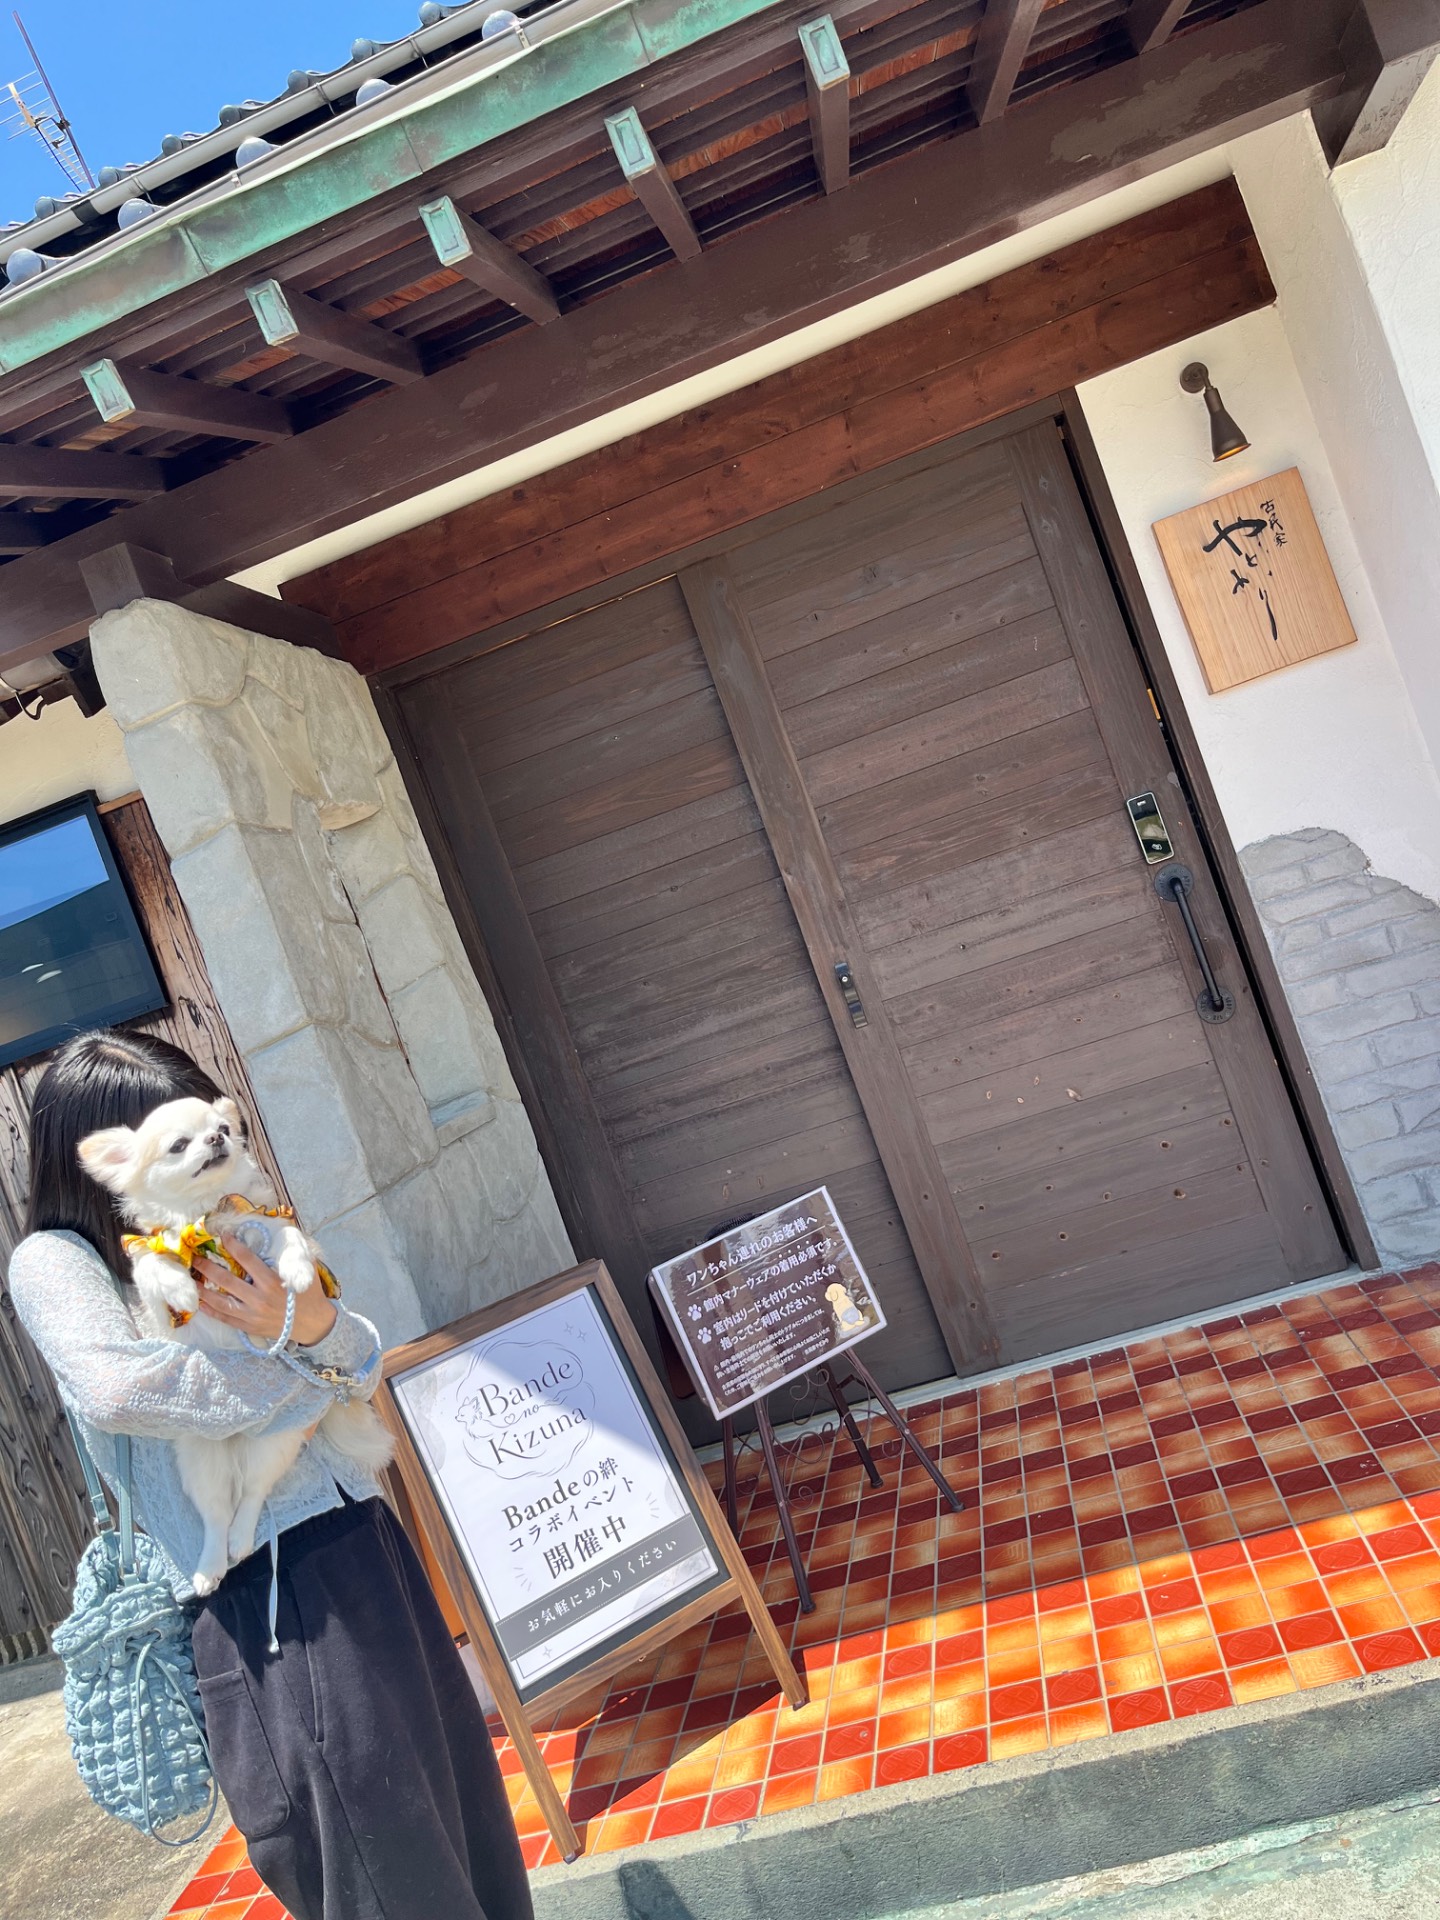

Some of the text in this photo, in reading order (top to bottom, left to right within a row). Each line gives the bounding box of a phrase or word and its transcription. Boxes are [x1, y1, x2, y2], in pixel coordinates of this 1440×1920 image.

[1260, 498, 1288, 547] 古民家
[686, 1215, 818, 1287] ワンちゃん連れのお客様へ
[703, 1238, 837, 1312] 館内マナーウェアの着用必須です。
[713, 1263, 837, 1335] 室内はリードを付けていただくか
[720, 1296, 817, 1351] 抱っこでご利用ください。
[476, 1361, 574, 1418] Bande
[523, 1403, 541, 1418] no
[487, 1408, 588, 1465] Kizuna
[501, 1457, 618, 1531] Bandeの絆
[508, 1476, 635, 1554] コラボイベント
[542, 1514, 627, 1580] 開催中
[527, 1538, 677, 1632] お気軽にお入りください
